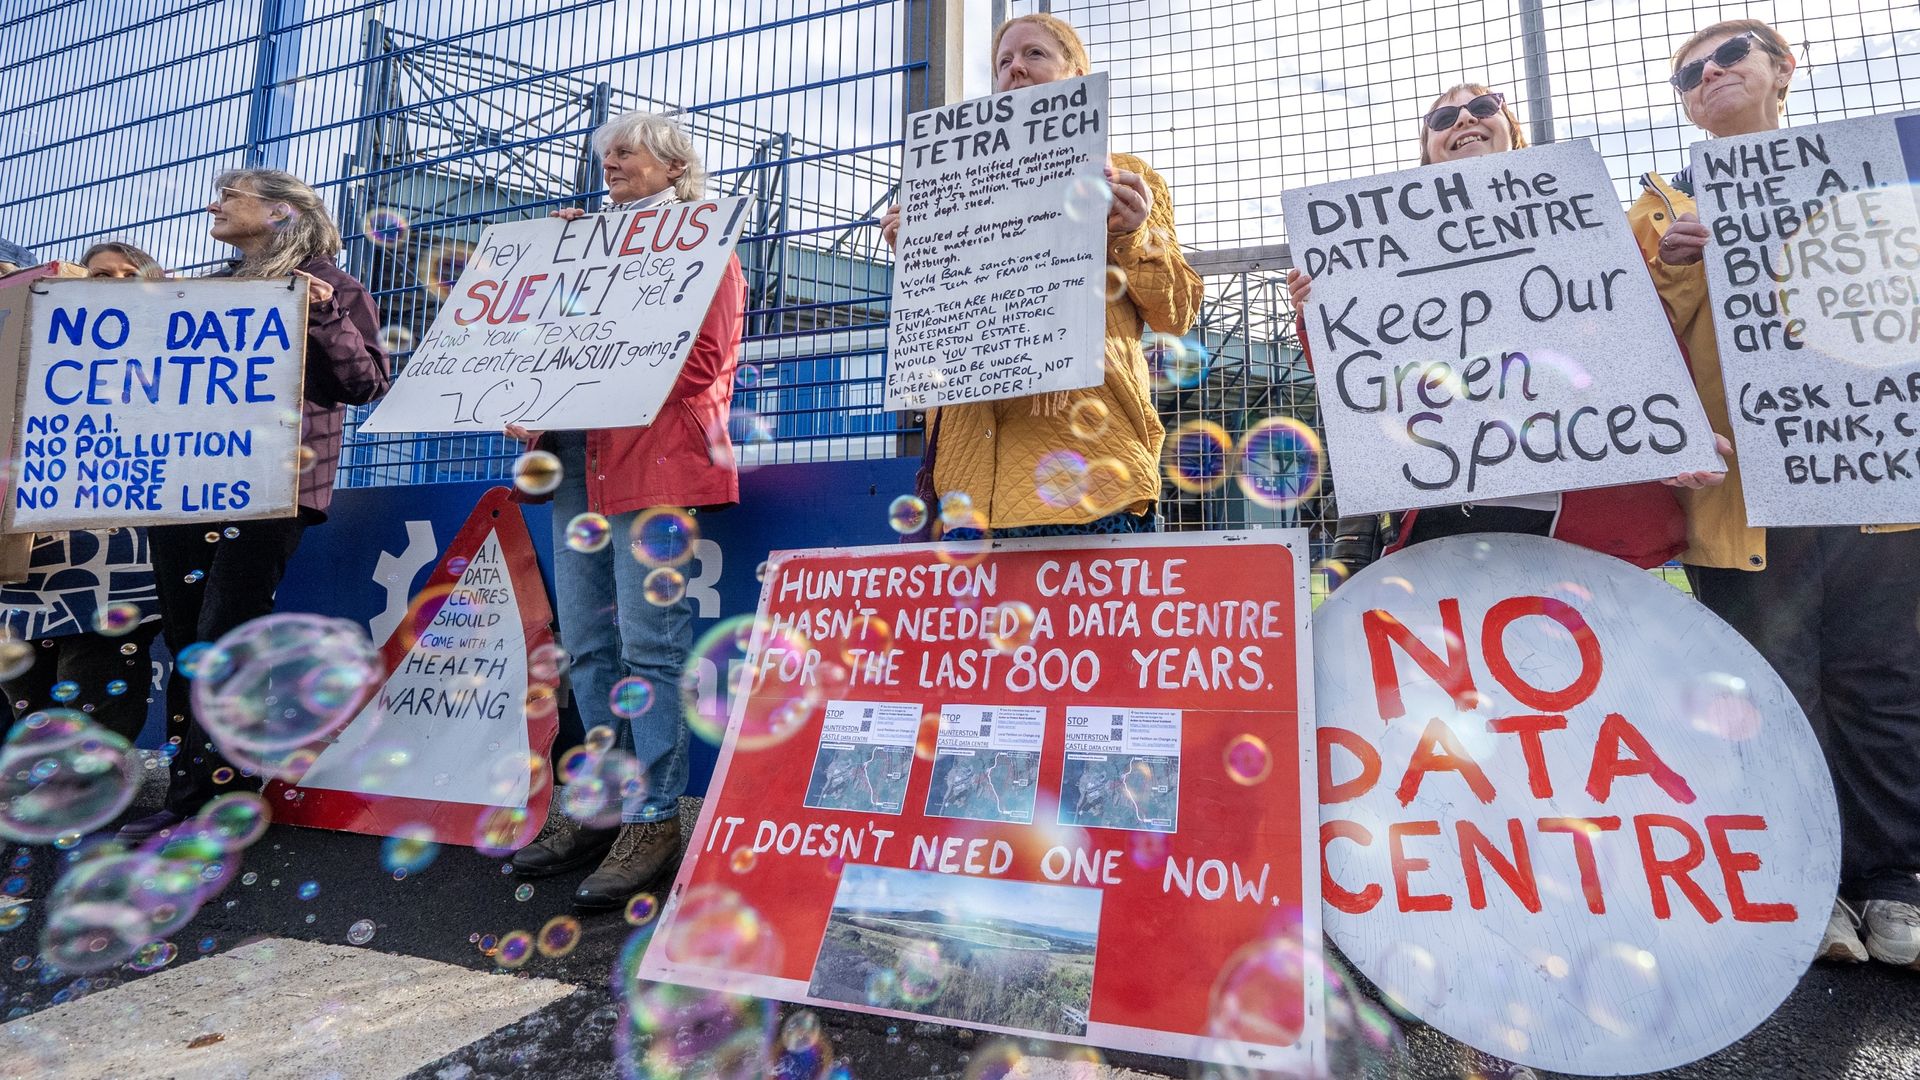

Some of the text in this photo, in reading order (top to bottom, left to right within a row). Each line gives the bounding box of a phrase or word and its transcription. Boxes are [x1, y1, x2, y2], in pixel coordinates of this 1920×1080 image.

[913, 82, 1088, 140] ENEUS and
[910, 109, 1099, 168] TETRA TECH
[1704, 134, 1831, 180] WHEN
[906, 179, 938, 192] Tetra
[1019, 146, 1075, 166] radiation
[1044, 153, 1089, 170] samples.
[907, 200, 929, 213] cost
[969, 183, 1009, 198] million.
[1011, 177, 1036, 188] Two
[1036, 168, 1075, 187] jailed.
[934, 203, 960, 217] dept.
[964, 195, 995, 210] sued.
[1308, 168, 1558, 236] DITCH the
[1703, 161, 1888, 212] THE A.I.
[474, 197, 747, 280] hey ENEUS!
[903, 211, 1062, 249] Accused of dumping radio-
[1303, 193, 1604, 279] DATA CENTRE
[1712, 192, 1890, 246] BUBBLE
[903, 246, 938, 261] active
[944, 233, 995, 251] material
[1723, 226, 1920, 287] BURSTS
[901, 249, 1051, 289] World Bank sanctioned
[903, 286, 936, 299] Tetra
[974, 275, 990, 284] for
[996, 264, 1029, 279] FRAUD
[1035, 261, 1046, 269] in
[454, 273, 549, 326] SUE
[623, 254, 675, 281] else
[964, 295, 986, 309] ARE
[991, 289, 1025, 302] HIRED
[1027, 285, 1044, 294] TO
[1047, 282, 1060, 292] DO
[1062, 277, 1085, 288] THE
[1723, 288, 1800, 320] our
[48, 307, 290, 352] NO DATA
[896, 295, 1048, 335] ENVIRONMENTAL IMPACT
[898, 306, 1055, 346] ASSESSMENT ON HISTORIC
[1319, 264, 1628, 358] Keep Our
[534, 320, 617, 345] Texas
[894, 323, 1030, 360] HUNTERSTON ESTATE.
[1733, 318, 1806, 352] are
[407, 330, 691, 377] data centre LAWSUIT going?
[895, 355, 936, 371] WOULD
[942, 347, 966, 360] YOU
[971, 339, 1011, 356] TRUST
[927, 364, 967, 378] SOULD
[970, 360, 984, 371] BE
[991, 352, 1032, 367] UNDER
[45, 356, 276, 405] CENTRE
[890, 357, 1073, 398] INDEPENDENT CONTROL, NOT
[900, 378, 1032, 408] THE DEVELOPER!
[1336, 349, 1538, 414] Green
[26, 413, 118, 435] NO A.I.
[1739, 382, 1830, 426] (ASK
[25, 430, 251, 458] NO POLLUTION
[1402, 393, 1689, 492] Spaces
[1774, 413, 1884, 448] FINK,
[24, 458, 167, 484] NO NOISE
[1784, 447, 1920, 485] BLACK
[16, 480, 251, 511] NO MORE LIES
[474, 543, 499, 564] A.I.
[464, 567, 501, 585] DATA
[779, 558, 1188, 603] HUNTERSTON CASTLE
[449, 588, 509, 607] CENTRES
[433, 610, 500, 629] SHOULD
[769, 599, 1284, 643] HASN'T NEEDED A DATA CENTRE
[420, 633, 504, 651] COME WITH A
[1362, 595, 1603, 725] NO
[405, 652, 508, 680] HEALTH
[759, 647, 821, 687] FOR
[848, 648, 905, 687] THE
[919, 648, 998, 690] LAST
[1005, 644, 1101, 693] 800
[1131, 645, 1274, 692] YEARS.
[377, 685, 510, 720] WARNING
[826, 710, 844, 718] STOP
[1067, 717, 1089, 725] STOP
[1065, 733, 1109, 741] HUNTERSTON
[1317, 712, 1697, 807] DATA
[706, 816, 1281, 907] IT DOESN'T NEED ONE NOW.
[1321, 813, 1798, 924] CENTRE
